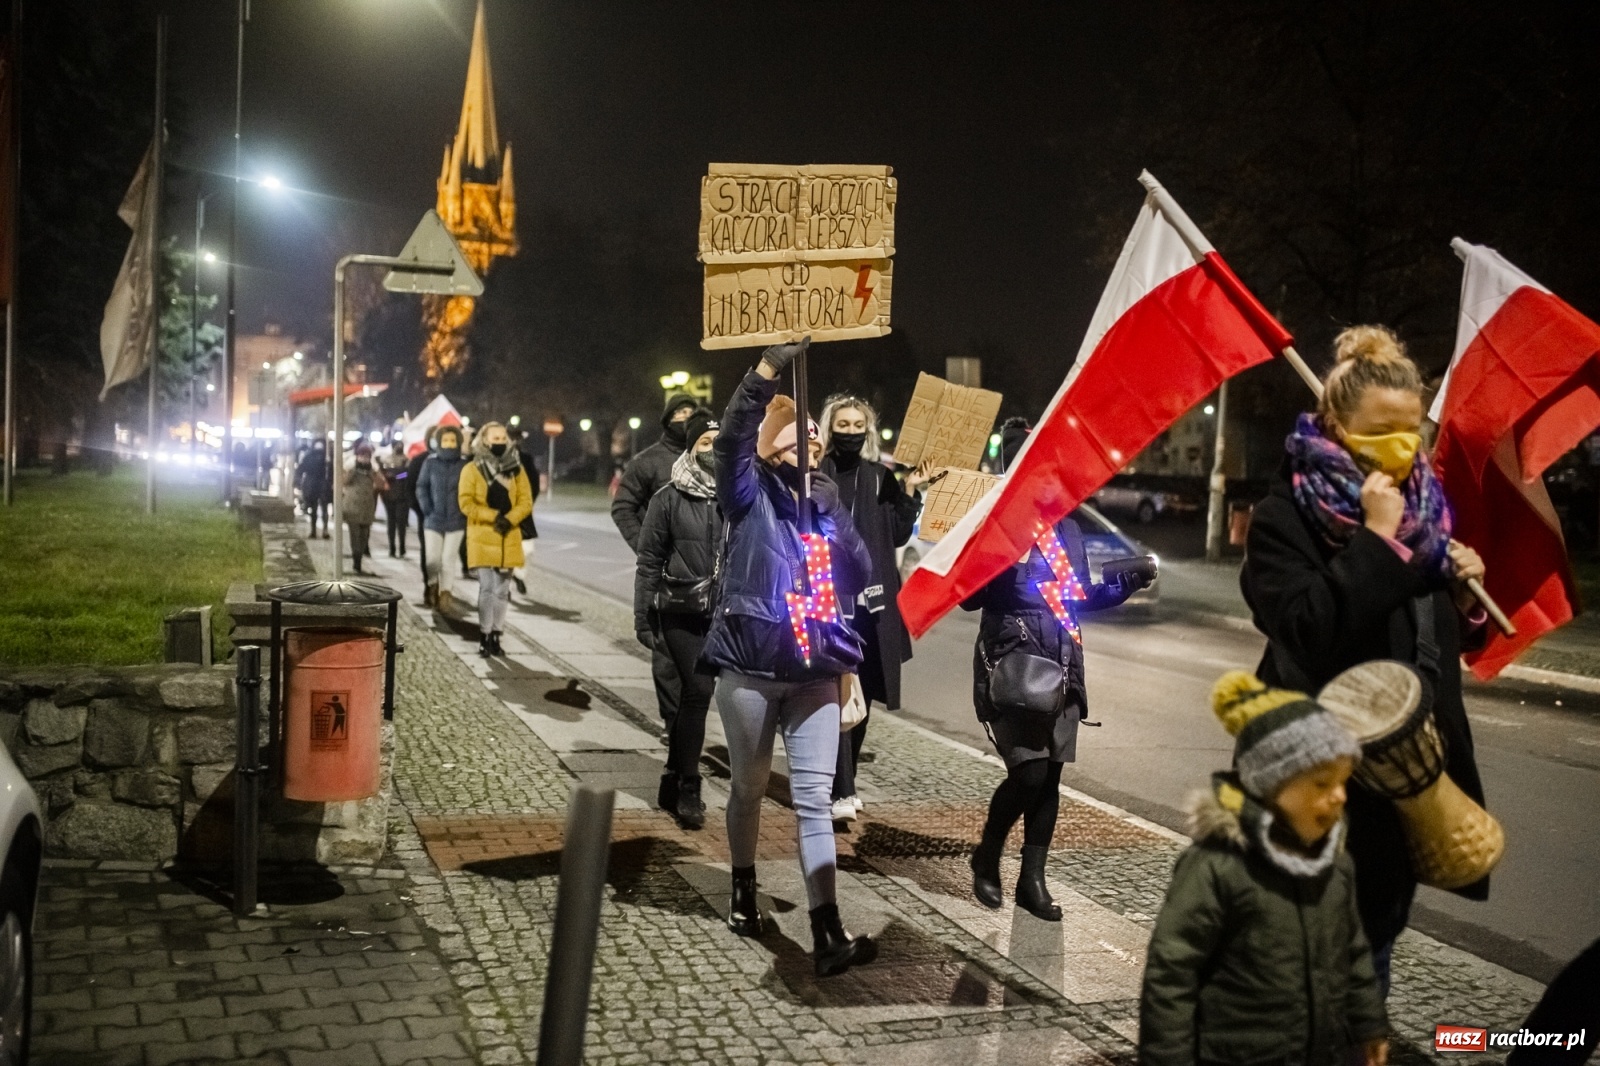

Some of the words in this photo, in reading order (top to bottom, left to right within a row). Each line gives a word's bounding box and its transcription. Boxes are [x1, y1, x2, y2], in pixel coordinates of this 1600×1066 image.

[718, 181, 800, 217] STRACH
[811, 183, 825, 215] W
[829, 181, 885, 219] OCZACH
[710, 213, 790, 255] KACZORA
[808, 214, 873, 250] LEPSZY
[781, 262, 810, 286] OD
[708, 286, 844, 337] WIBRATORA
[945, 387, 987, 416] NIE
[934, 427, 984, 448] MNIE
[934, 439, 963, 457] DO
